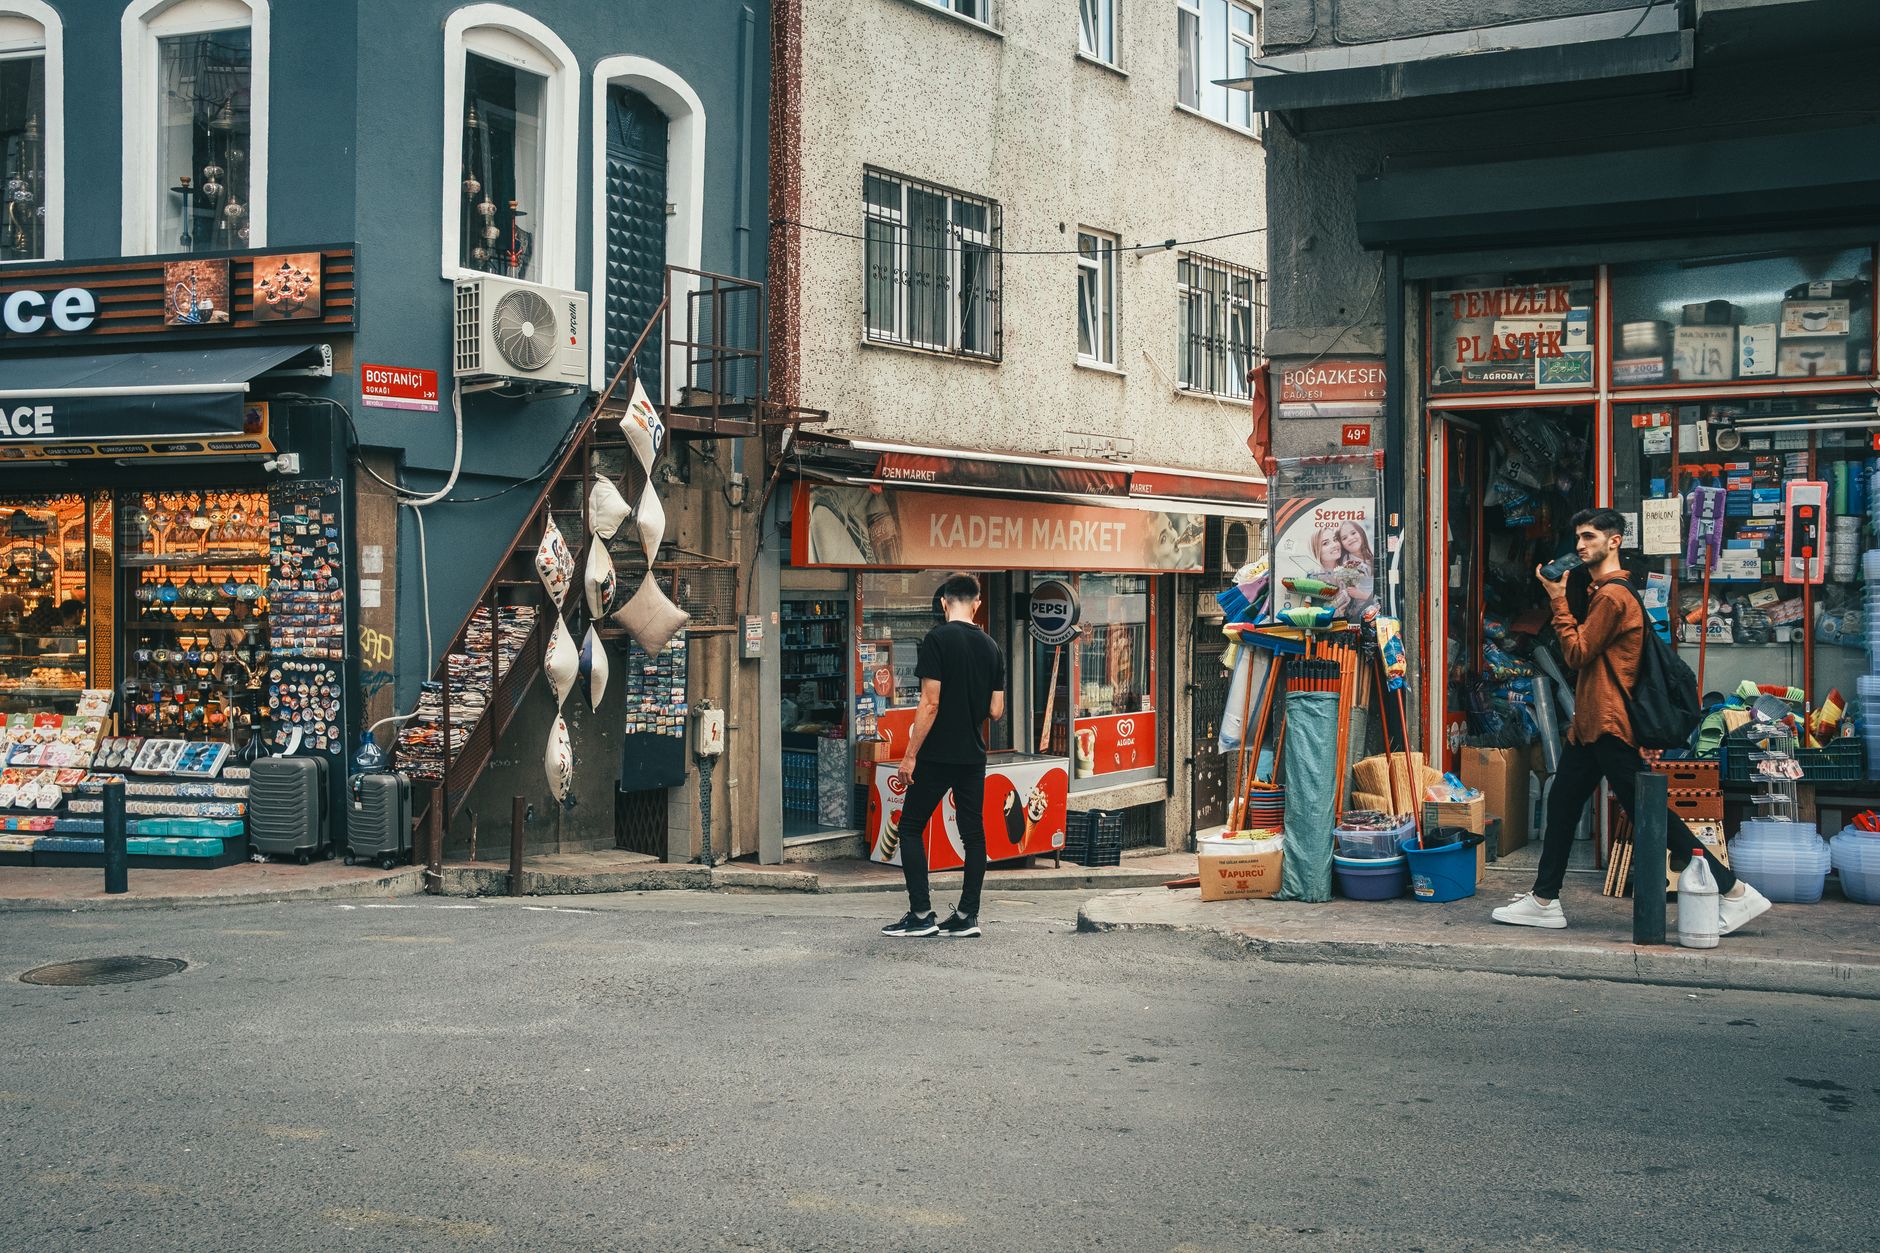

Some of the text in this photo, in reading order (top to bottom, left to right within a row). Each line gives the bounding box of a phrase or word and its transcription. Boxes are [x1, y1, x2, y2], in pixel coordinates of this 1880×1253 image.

[4, 288, 96, 333] ce
[366, 370, 422, 388] BOSTANİÇİ
[1483, 372, 1524, 380] AGROBAY
[903, 469, 936, 481] MARKET
[1130, 482, 1152, 494] MARKET
[1315, 508, 1366, 521] Serena
[929, 513, 1126, 552] KADEM MARKET
[1032, 602, 1067, 615] PEPSI
[1218, 868, 1264, 879] VAPURCU
